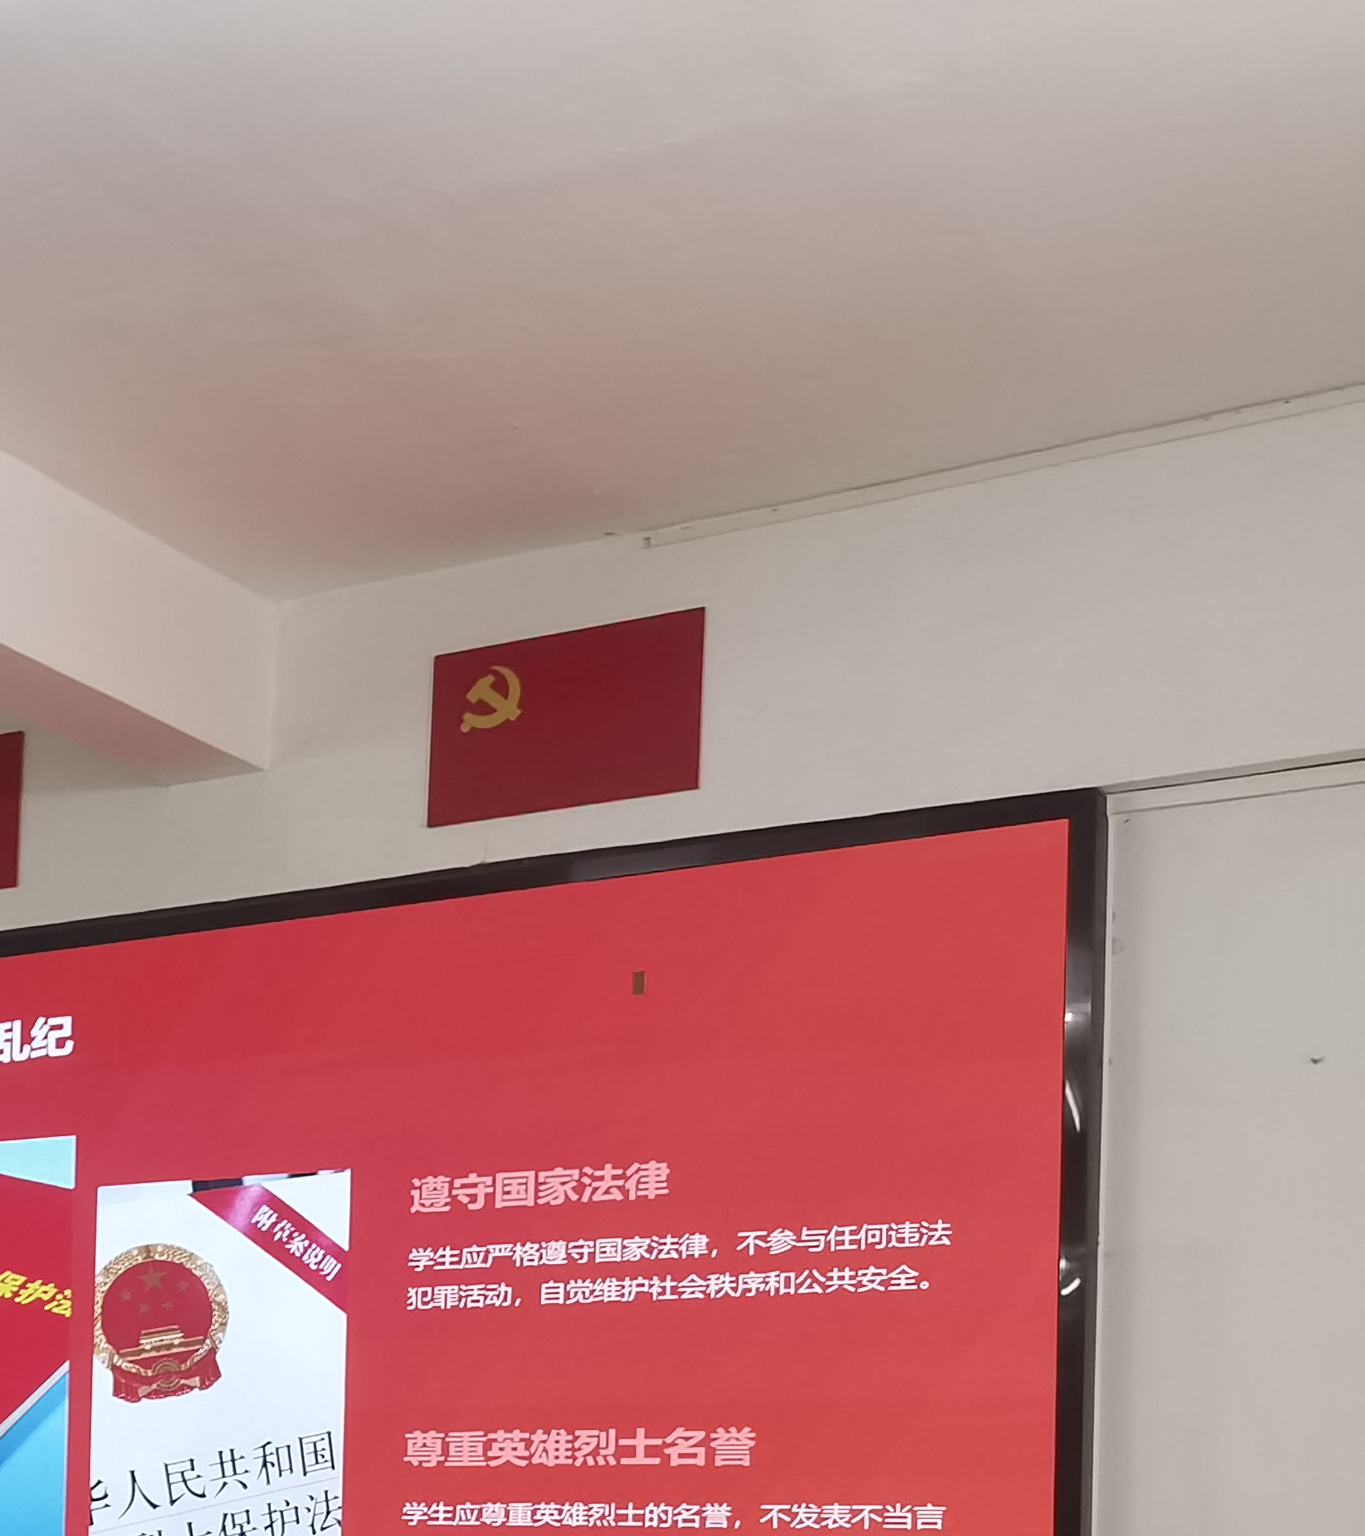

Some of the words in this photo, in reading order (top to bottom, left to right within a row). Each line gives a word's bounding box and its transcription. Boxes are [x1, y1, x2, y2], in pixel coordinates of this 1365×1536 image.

[410, 1160, 671, 1214] 遵守国家法律
[250, 1203, 342, 1282] 附草案说明
[407, 1219, 953, 1272] 学生应严格遵守国家法律，不参与任何违法
[405, 1265, 931, 1311] 犯罪活动，自觉维护社会秩序和公共安全。
[402, 1426, 757, 1468] 尊重英雄烈士名誉
[401, 1501, 947, 1531] 学生应尊重英雄烈士的名誉，不发表不当言
